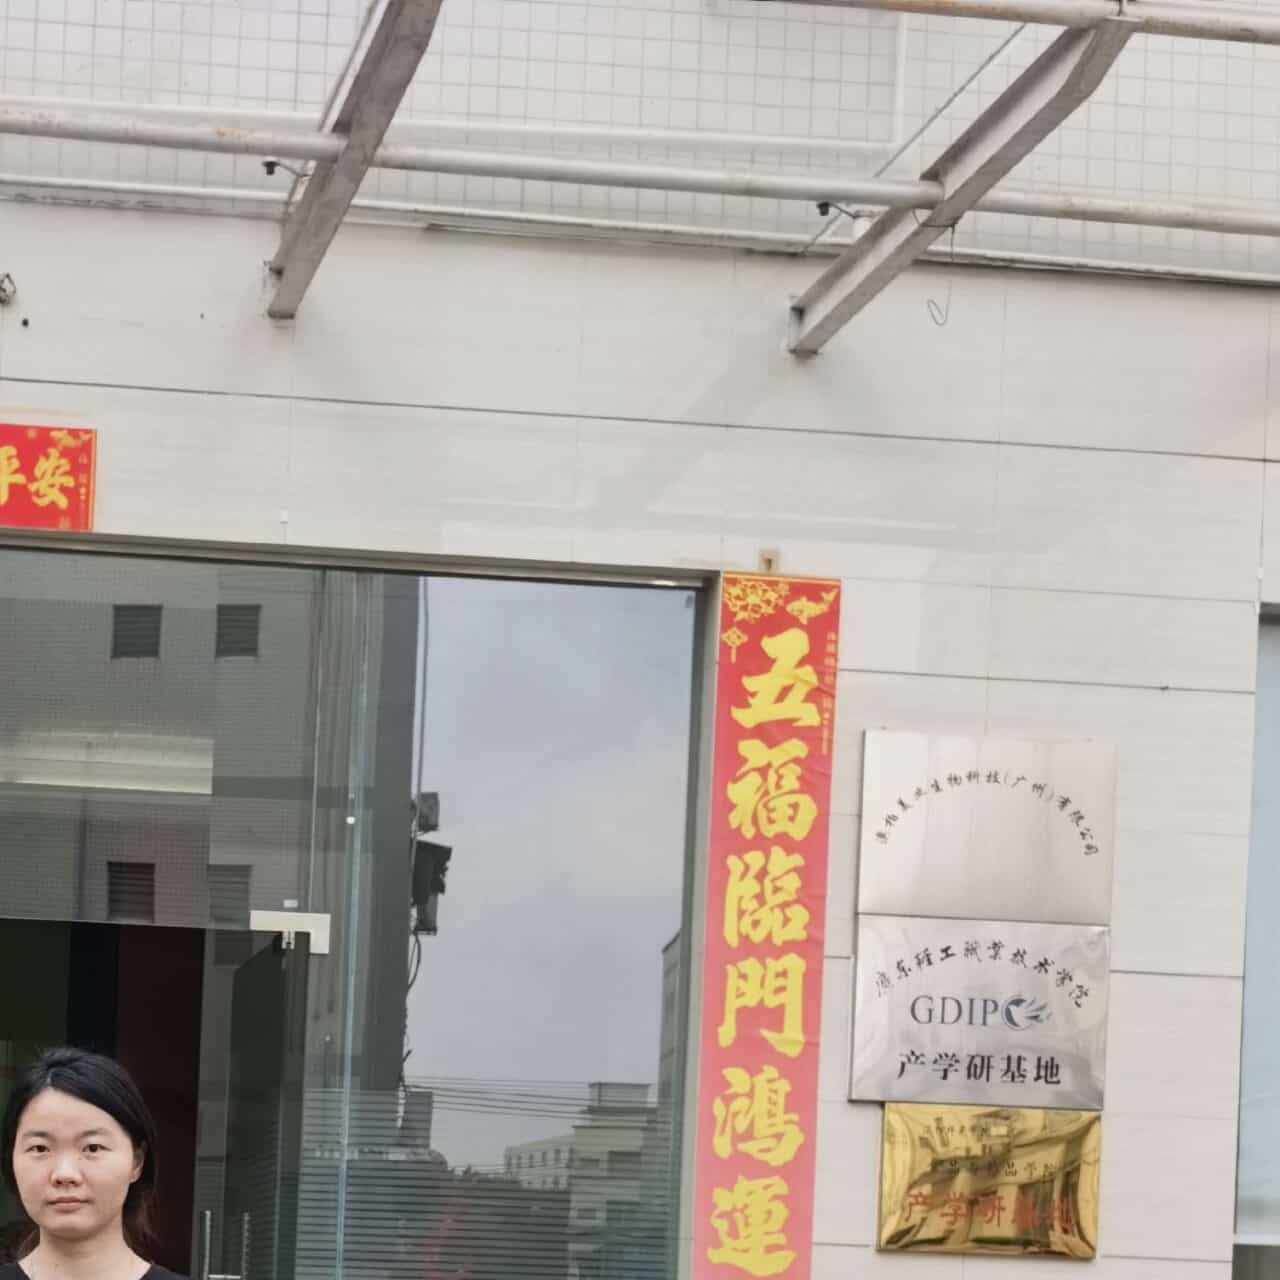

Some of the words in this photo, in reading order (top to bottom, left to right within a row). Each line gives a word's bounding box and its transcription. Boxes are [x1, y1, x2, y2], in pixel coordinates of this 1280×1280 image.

[896, 1049, 1061, 1086] 产学研基地
